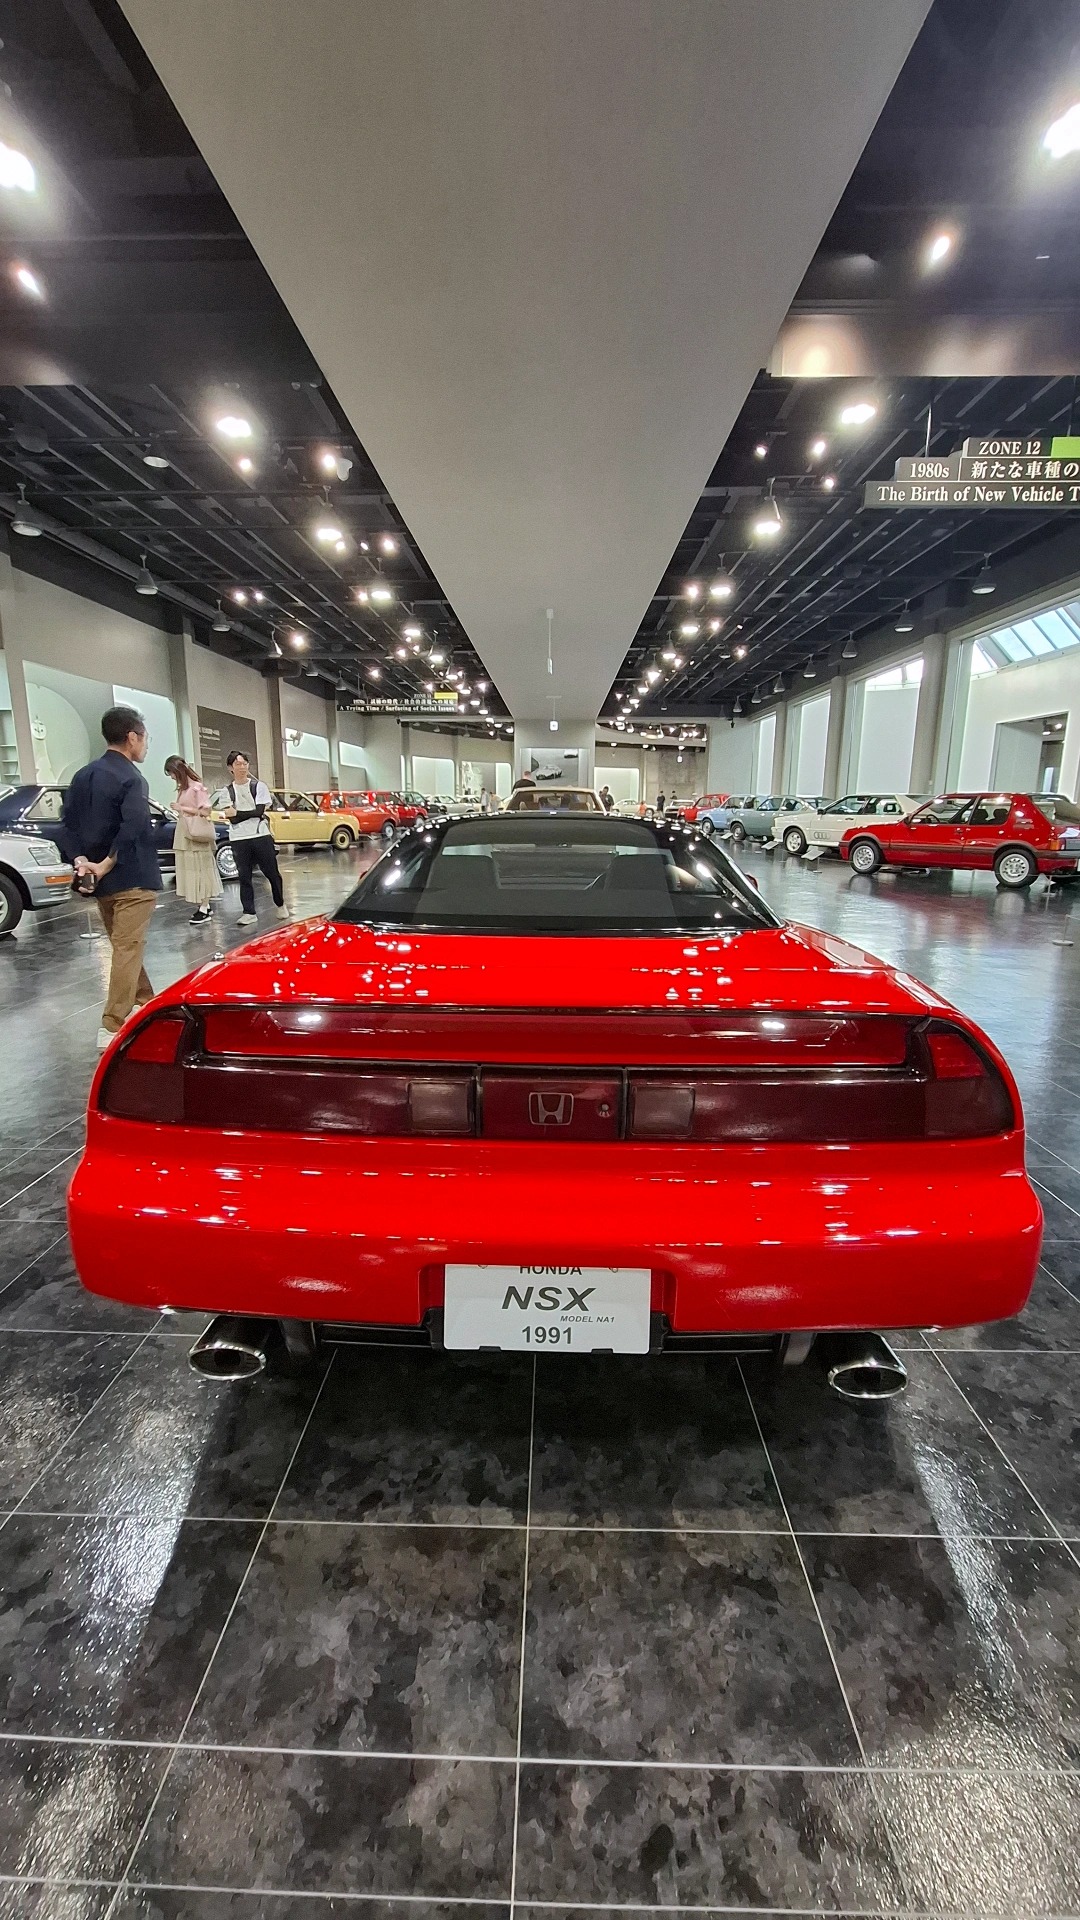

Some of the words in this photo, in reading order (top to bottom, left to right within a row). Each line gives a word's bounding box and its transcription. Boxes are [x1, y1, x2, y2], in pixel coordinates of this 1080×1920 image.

[979, 441, 1022, 456] ZONE
[1026, 441, 1041, 455] 12
[909, 462, 950, 478] 1980s
[971, 460, 1080, 479] 新たな車種の
[877, 486, 906, 501] The
[910, 486, 949, 502] Birth
[953, 486, 970, 502] of
[974, 486, 1006, 501] New
[1011, 485, 1064, 502] Vehicle
[502, 1286, 597, 1312] NSX
[522, 1326, 573, 1344] 1991
